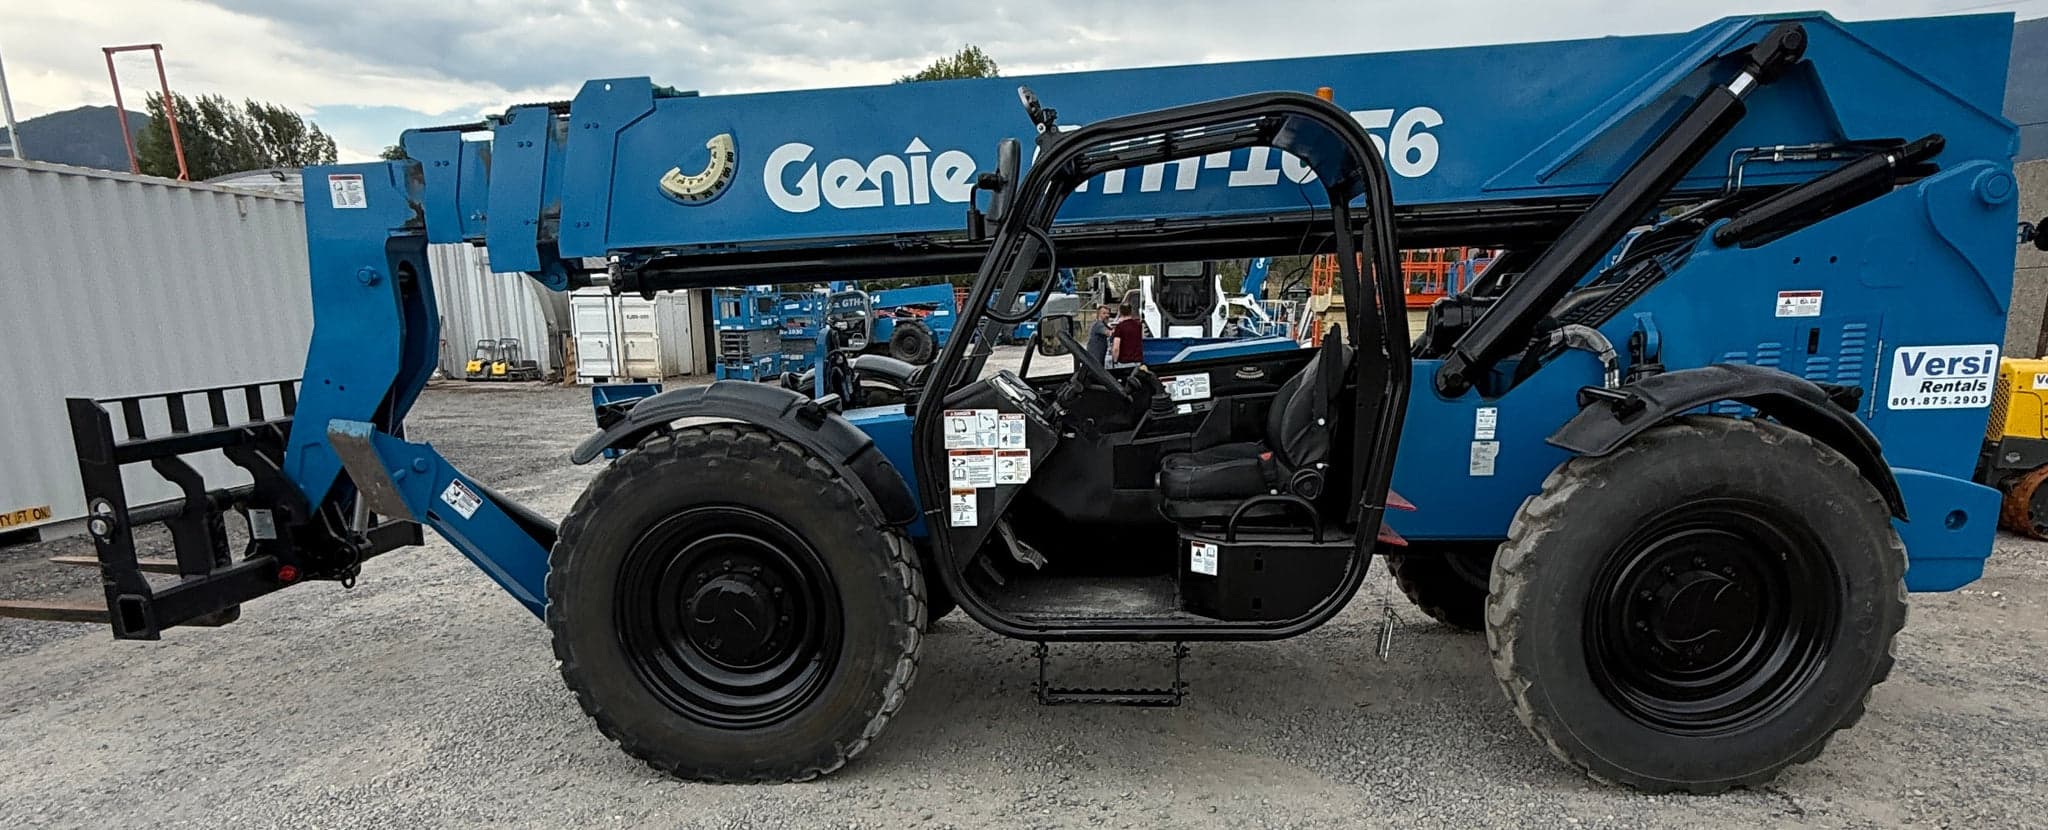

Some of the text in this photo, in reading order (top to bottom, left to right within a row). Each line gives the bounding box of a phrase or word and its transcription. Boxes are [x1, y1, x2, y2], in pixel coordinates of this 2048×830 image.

[764, 106, 1444, 213] Genie H-156
[1901, 350, 1993, 377] Versi
[1920, 379, 1987, 394] Rentals
[1892, 395, 1987, 407] 801.875.2903
